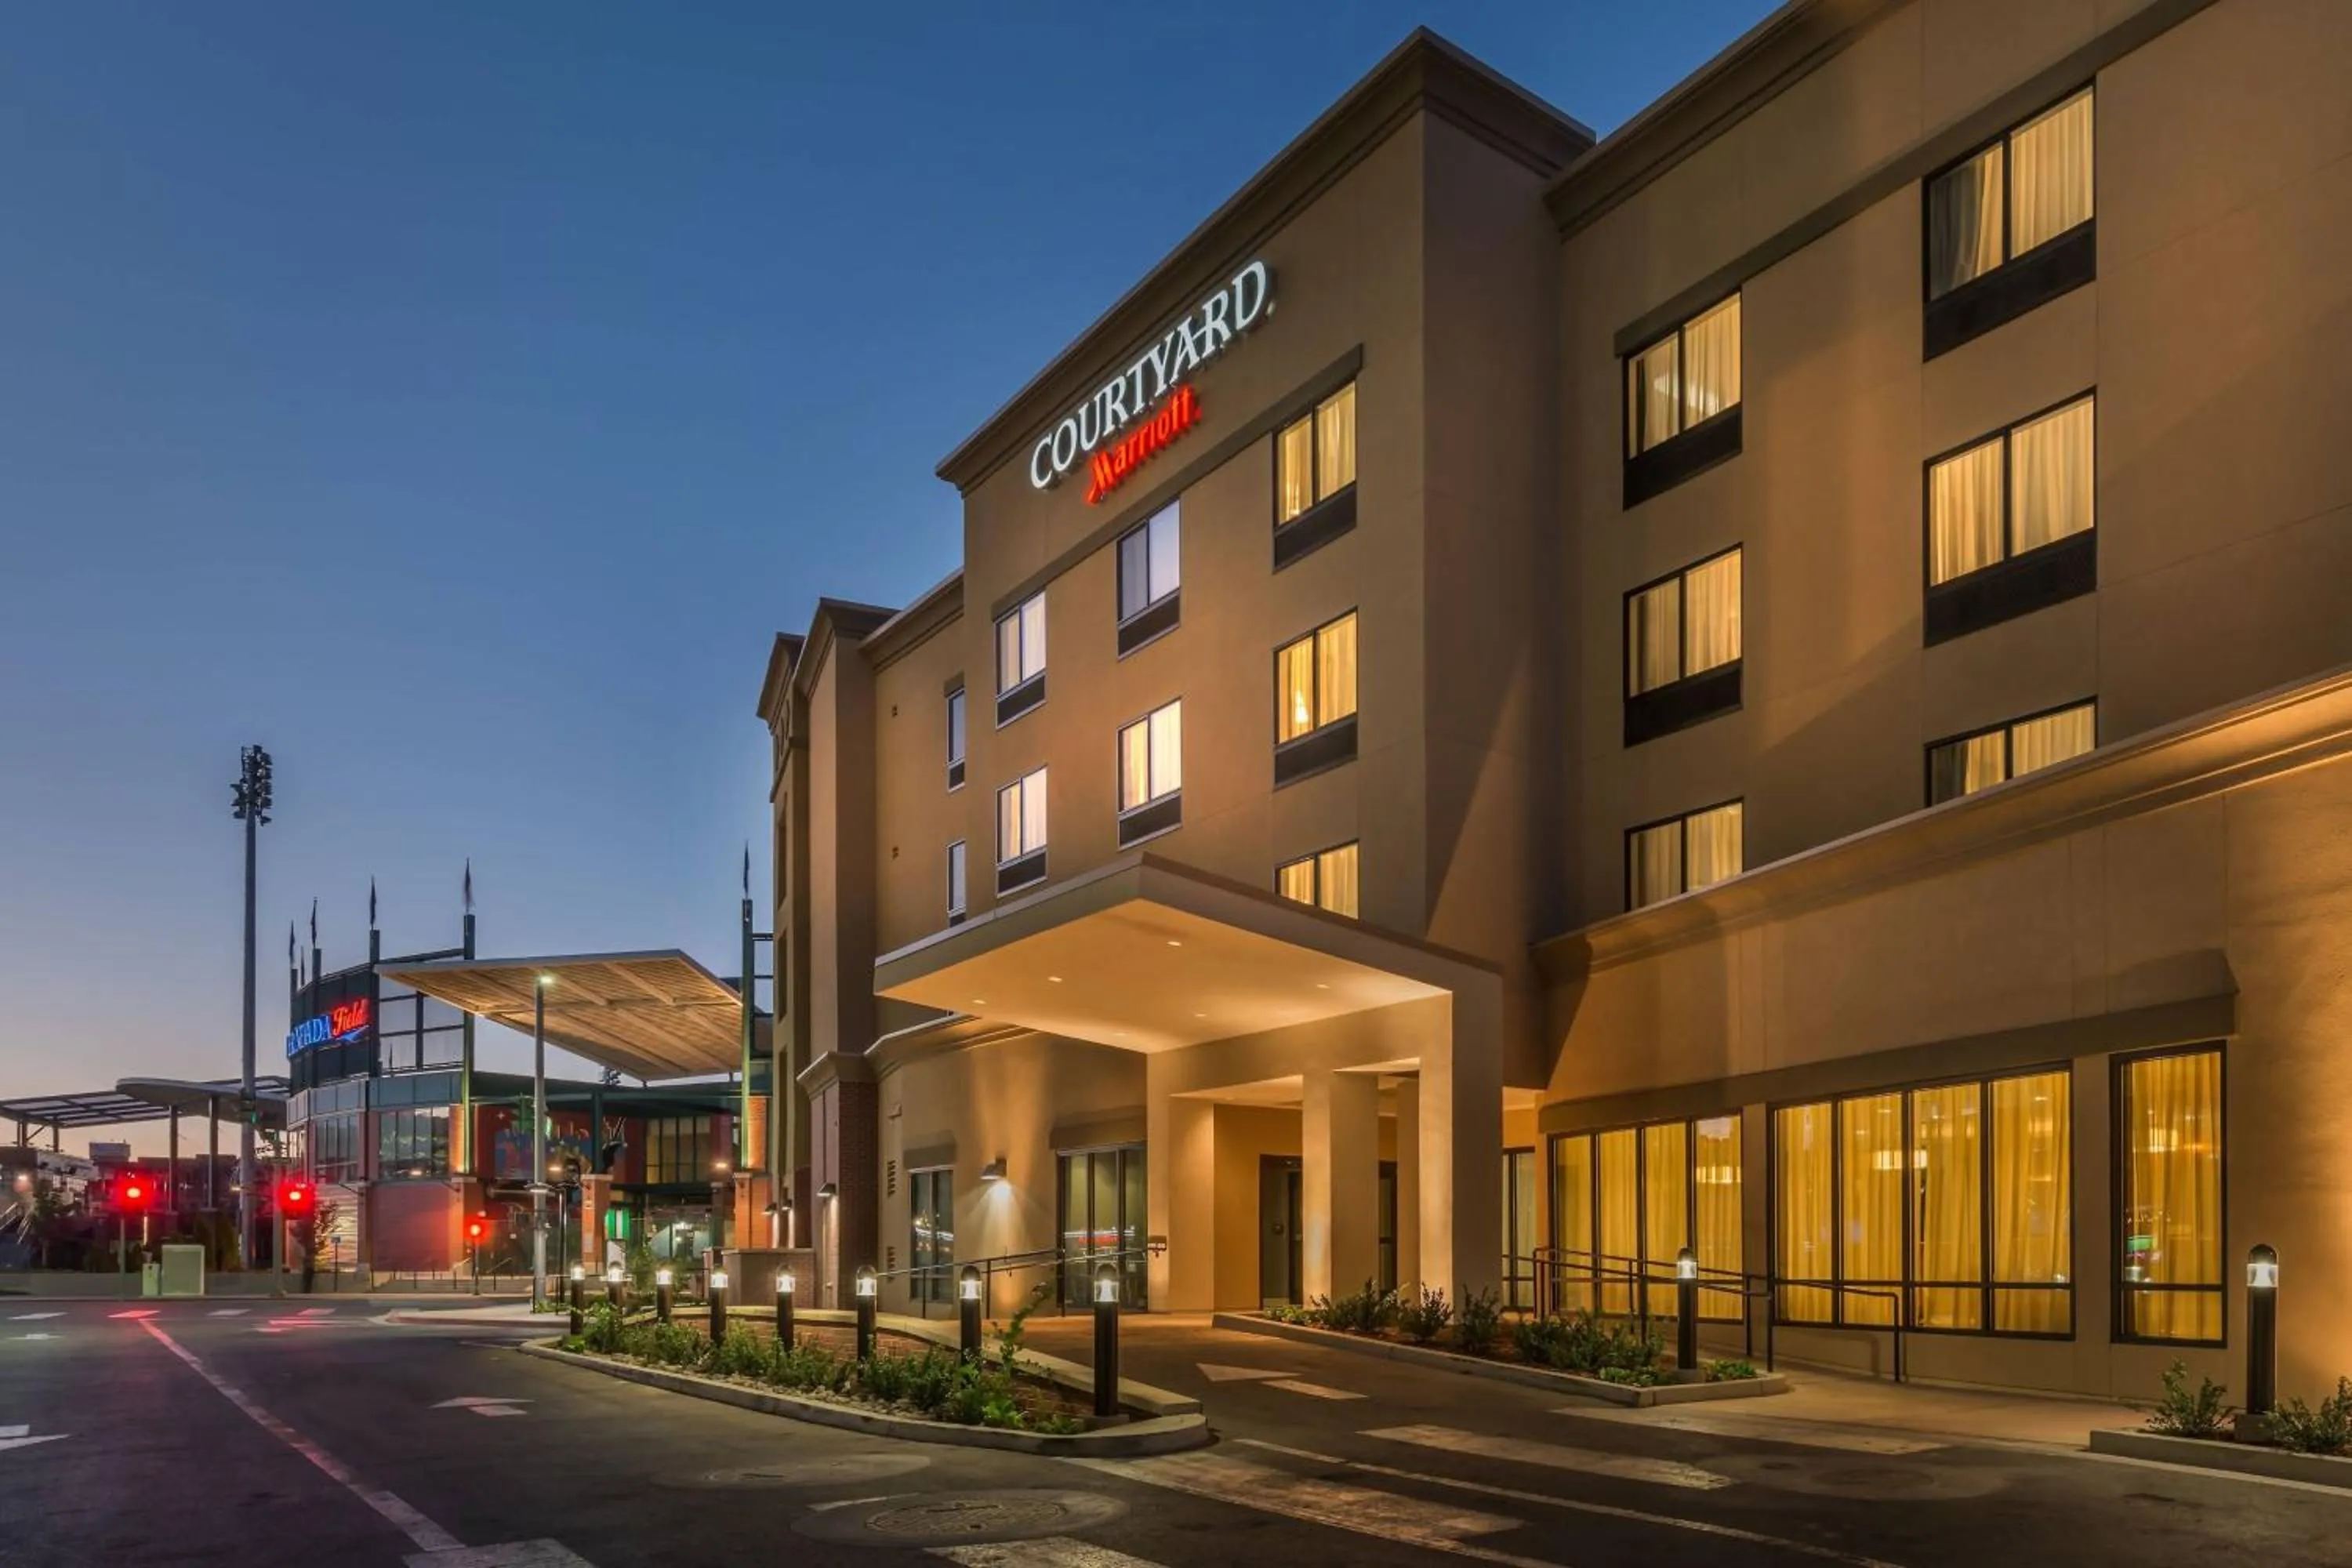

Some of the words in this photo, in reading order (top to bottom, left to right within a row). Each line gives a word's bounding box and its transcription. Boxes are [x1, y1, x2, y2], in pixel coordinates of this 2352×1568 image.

[1030, 260, 1267, 489] COURTYARD
[1087, 386, 1196, 503] Marriott
[332, 998, 368, 1036] Field
